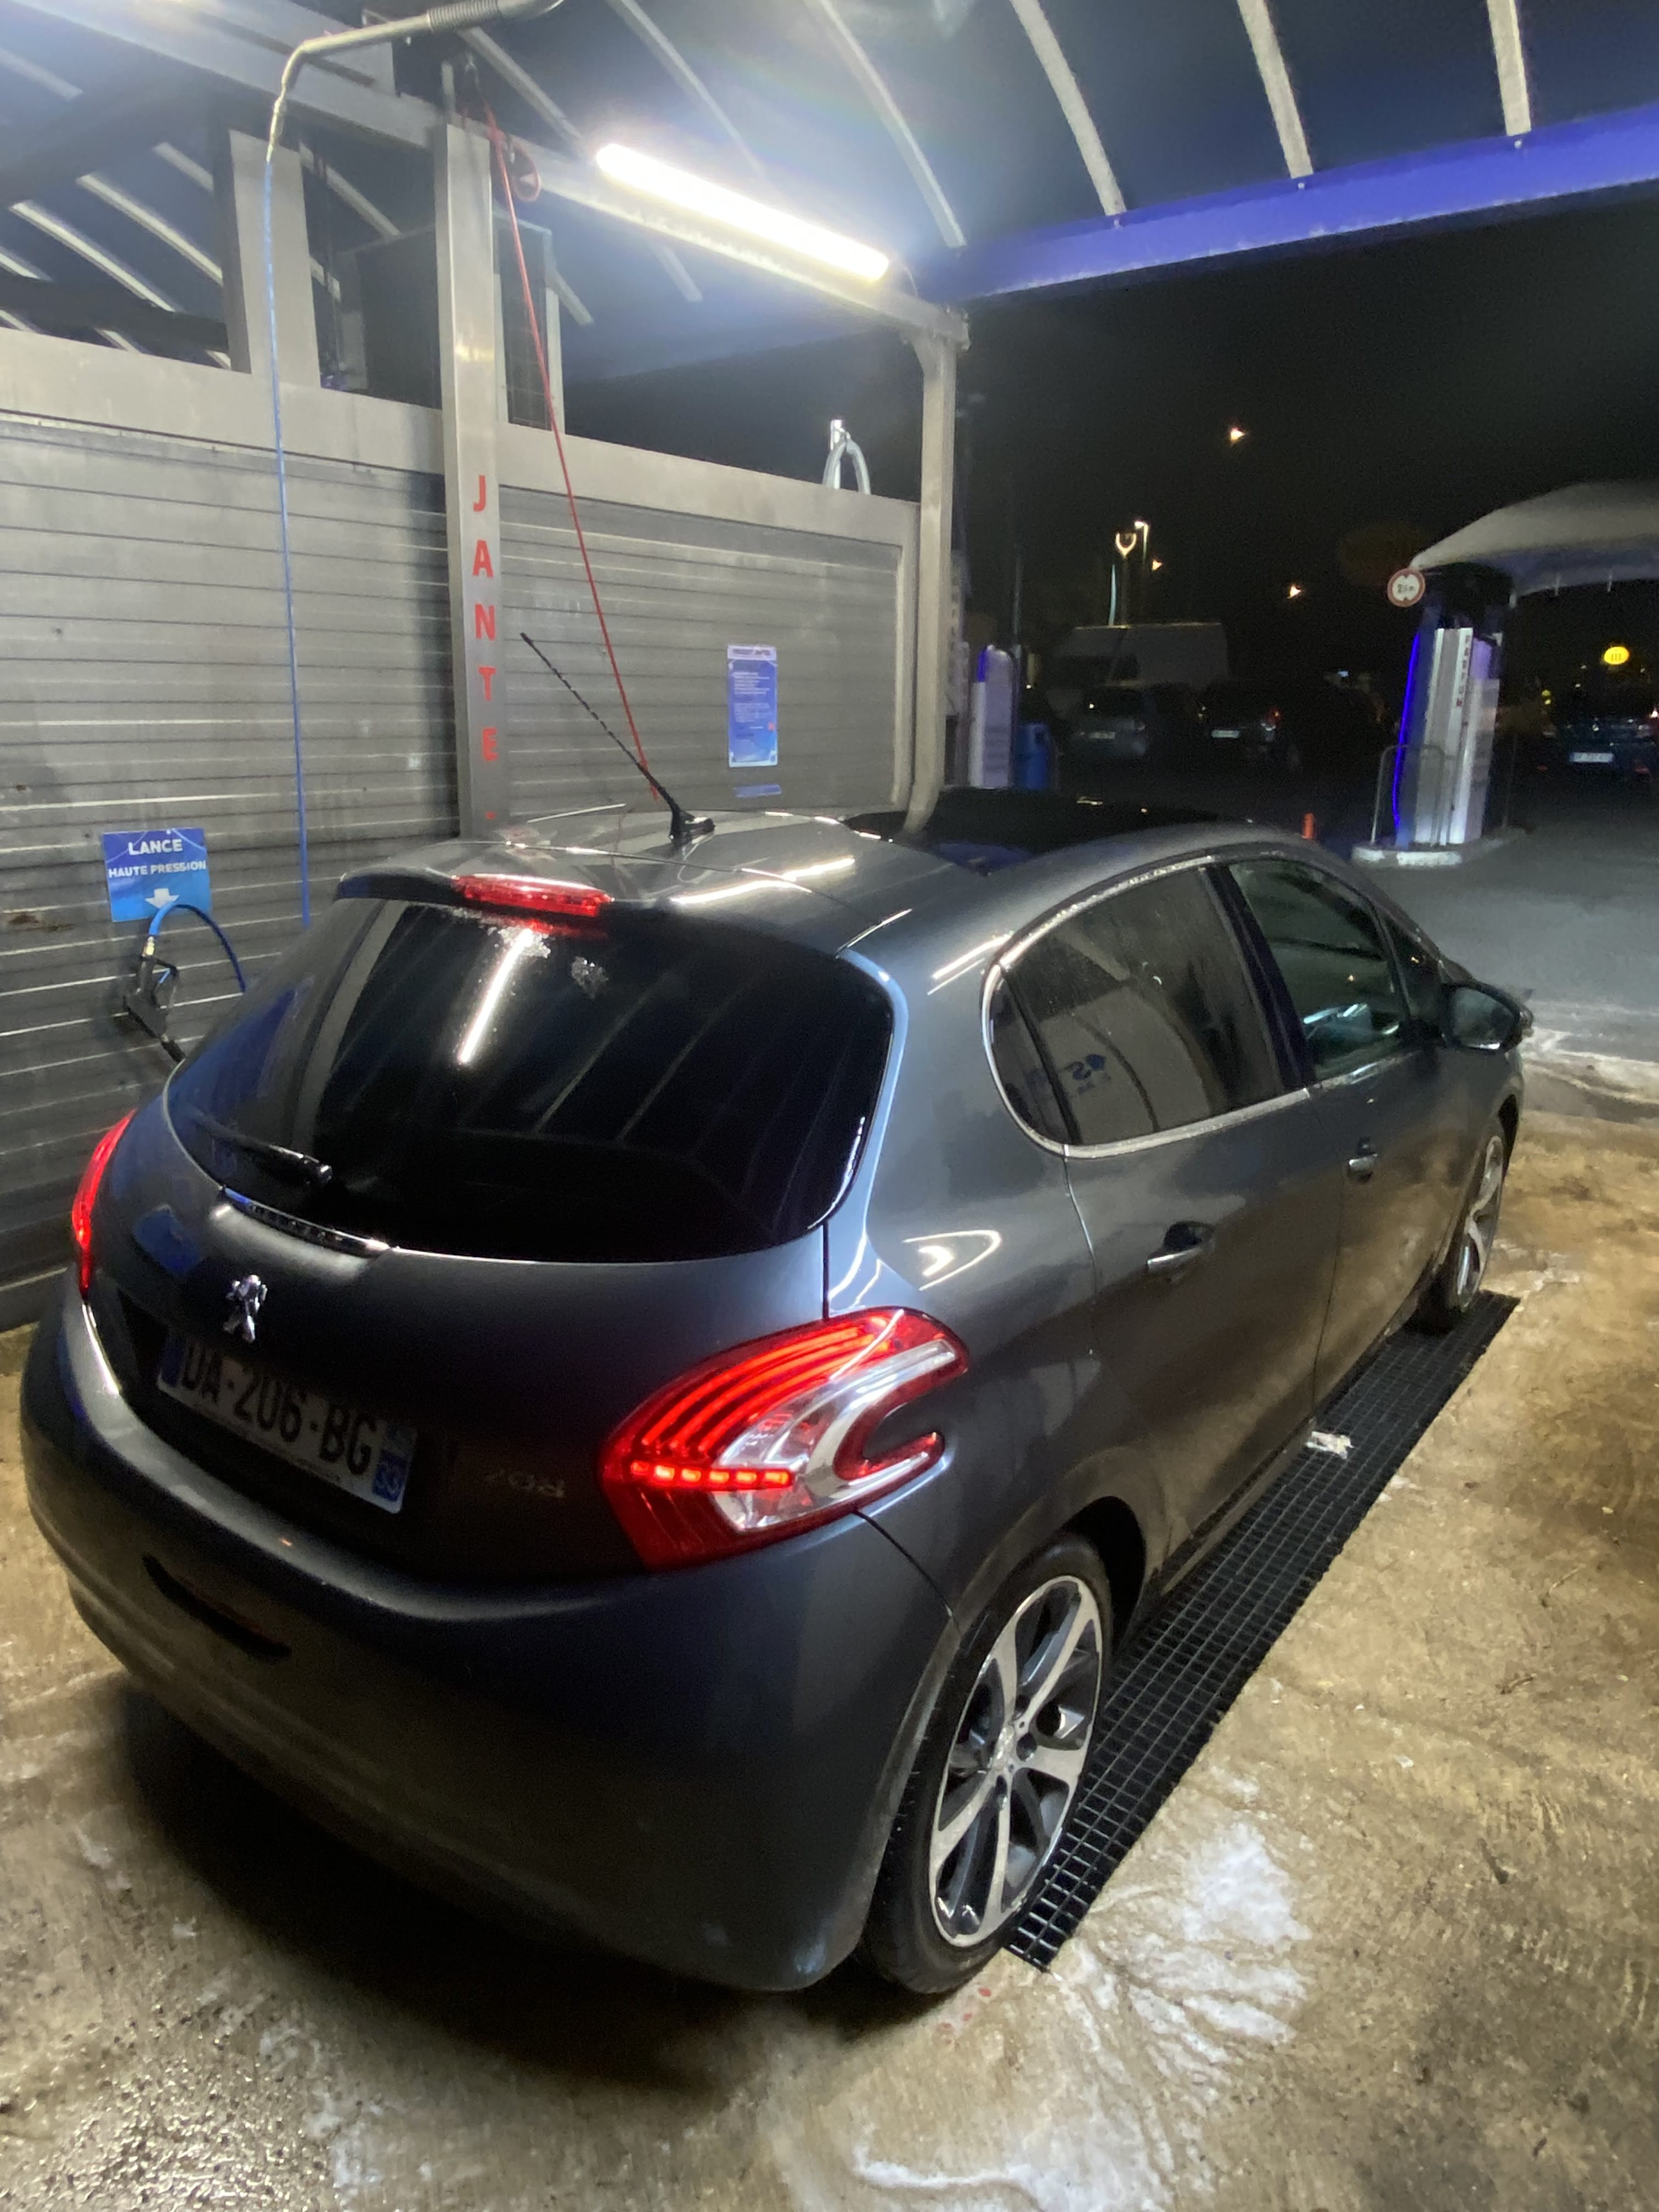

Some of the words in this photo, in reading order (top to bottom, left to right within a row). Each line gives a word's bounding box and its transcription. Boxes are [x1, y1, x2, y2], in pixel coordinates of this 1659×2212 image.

[472, 475, 498, 820] JANTE
[128, 839, 183, 855] LANCE
[108, 865, 148, 878] HAUTE
[151, 860, 206, 874] PRESSION
